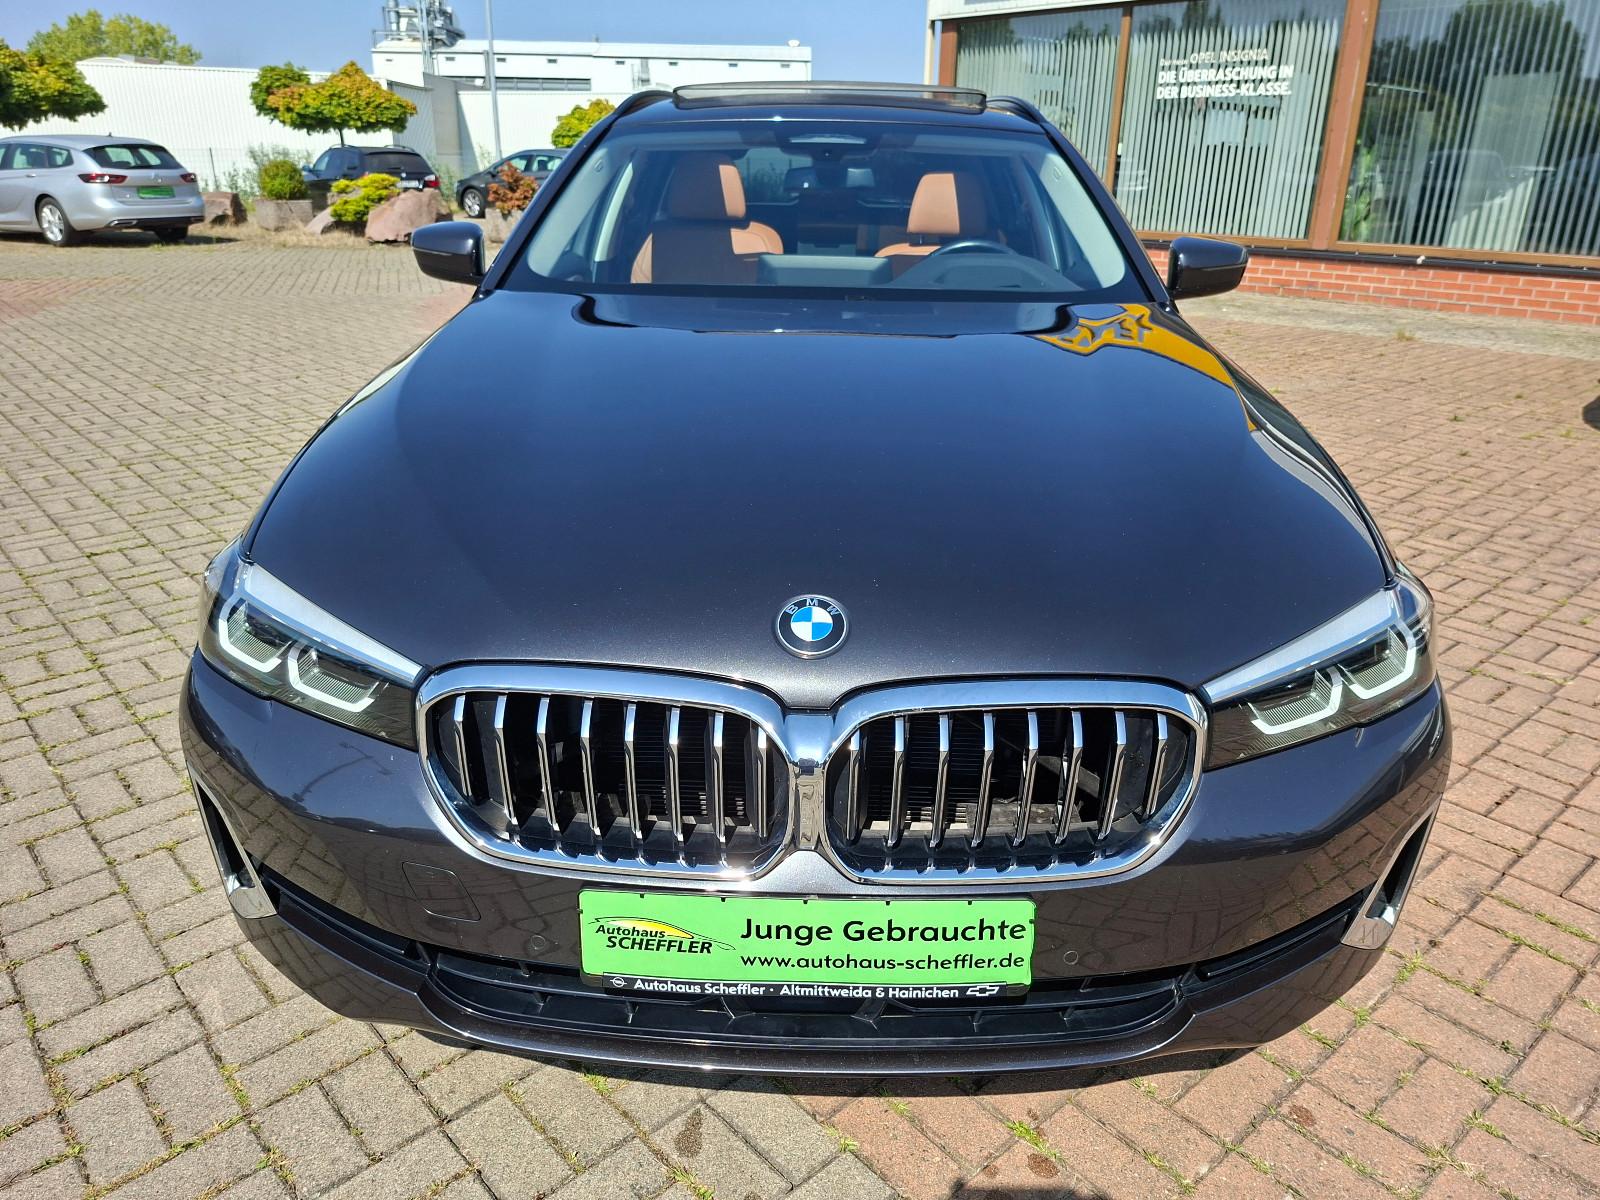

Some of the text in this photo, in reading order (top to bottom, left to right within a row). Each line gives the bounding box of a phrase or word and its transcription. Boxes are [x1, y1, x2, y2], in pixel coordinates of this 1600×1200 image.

[1189, 51, 1216, 64] OPEL
[1219, 48, 1269, 62] INSIGNIA
[1158, 65, 1294, 84] DIE ÜBERRASCHUNG IN
[1156, 81, 1292, 99] DER BUSINESS-KLASSE.
[785, 598, 840, 615] BMW
[595, 925, 666, 938] Autohaus
[740, 918, 1026, 946] Junge Gebrauchte
[606, 936, 713, 954] SCHEFFLER
[740, 952, 1025, 969] www.autohaus-scheffler.de
[633, 979, 959, 998] Autohaus Scheffler Altmittweida & Hainichen
